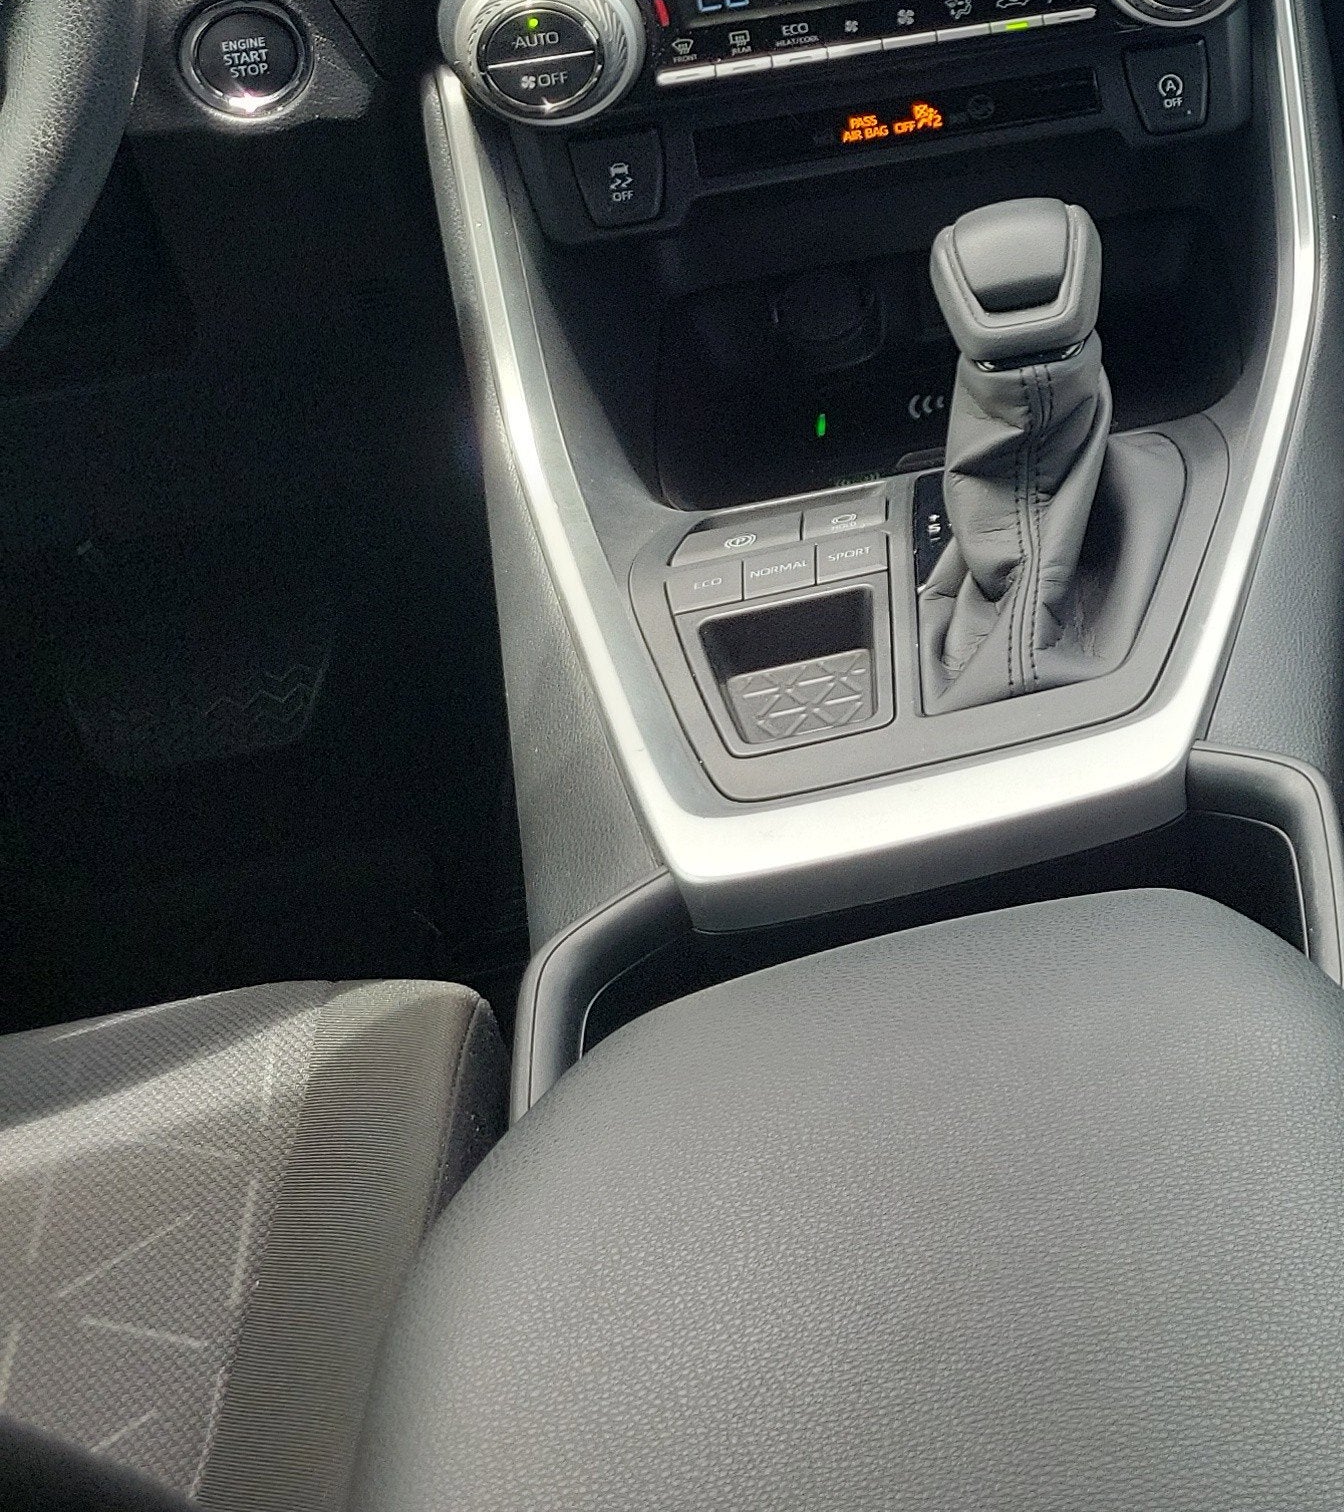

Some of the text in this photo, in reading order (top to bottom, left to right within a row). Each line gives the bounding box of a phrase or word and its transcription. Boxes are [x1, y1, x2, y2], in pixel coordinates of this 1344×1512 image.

[782, 23, 809, 37] ECO
[221, 37, 267, 53] ENGINE
[513, 31, 560, 51] AUTO
[223, 49, 269, 66] START
[672, 54, 698, 64] FRONT
[230, 63, 269, 79] STOP
[538, 71, 569, 87] OFF
[1163, 97, 1183, 110] OFF
[850, 114, 878, 129] PASS
[843, 129, 863, 144] AIR
[864, 125, 889, 140] BAG
[893, 120, 916, 134] OFF
[611, 189, 634, 203] OFF
[827, 546, 872, 562] SPORT
[750, 560, 808, 579] NORMAL
[693, 577, 722, 591] ECO
